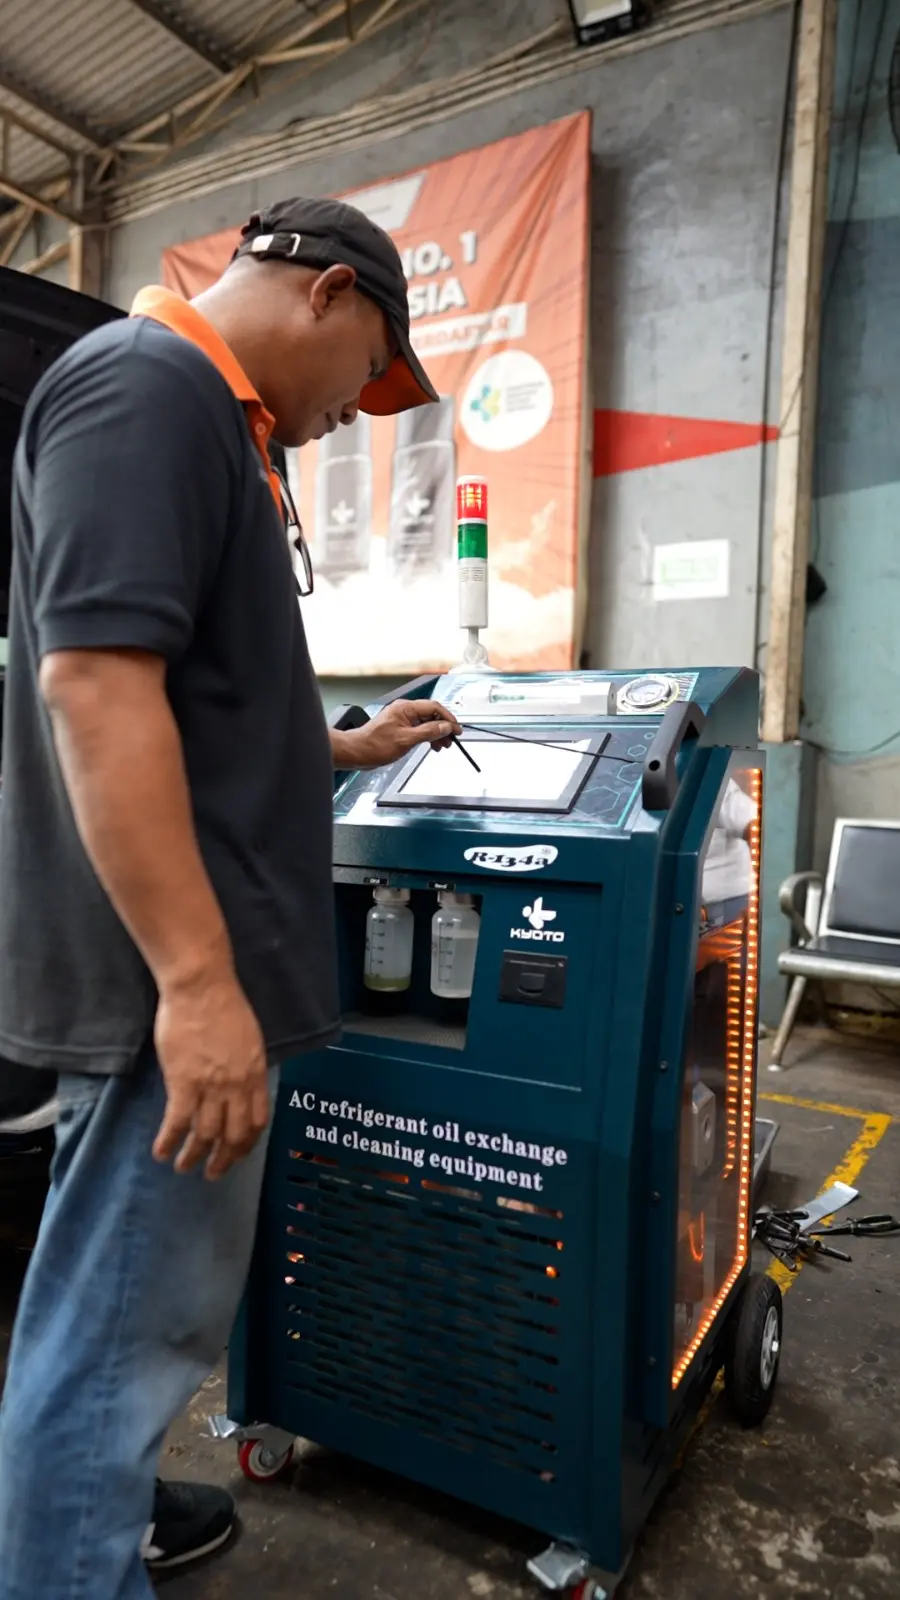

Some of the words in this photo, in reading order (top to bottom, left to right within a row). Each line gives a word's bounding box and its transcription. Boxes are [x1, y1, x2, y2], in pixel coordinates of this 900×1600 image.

[460, 231, 477, 264] 1
[472, 851, 549, 868] R-134a
[510, 928, 565, 942] KYOTO
[289, 1089, 316, 1111] AC
[319, 1100, 428, 1136] refrigerant
[432, 1121, 459, 1143] oil
[464, 1133, 568, 1167] exchange
[305, 1124, 338, 1144] and
[342, 1131, 425, 1168] cleaning
[429, 1152, 544, 1192] equipment
